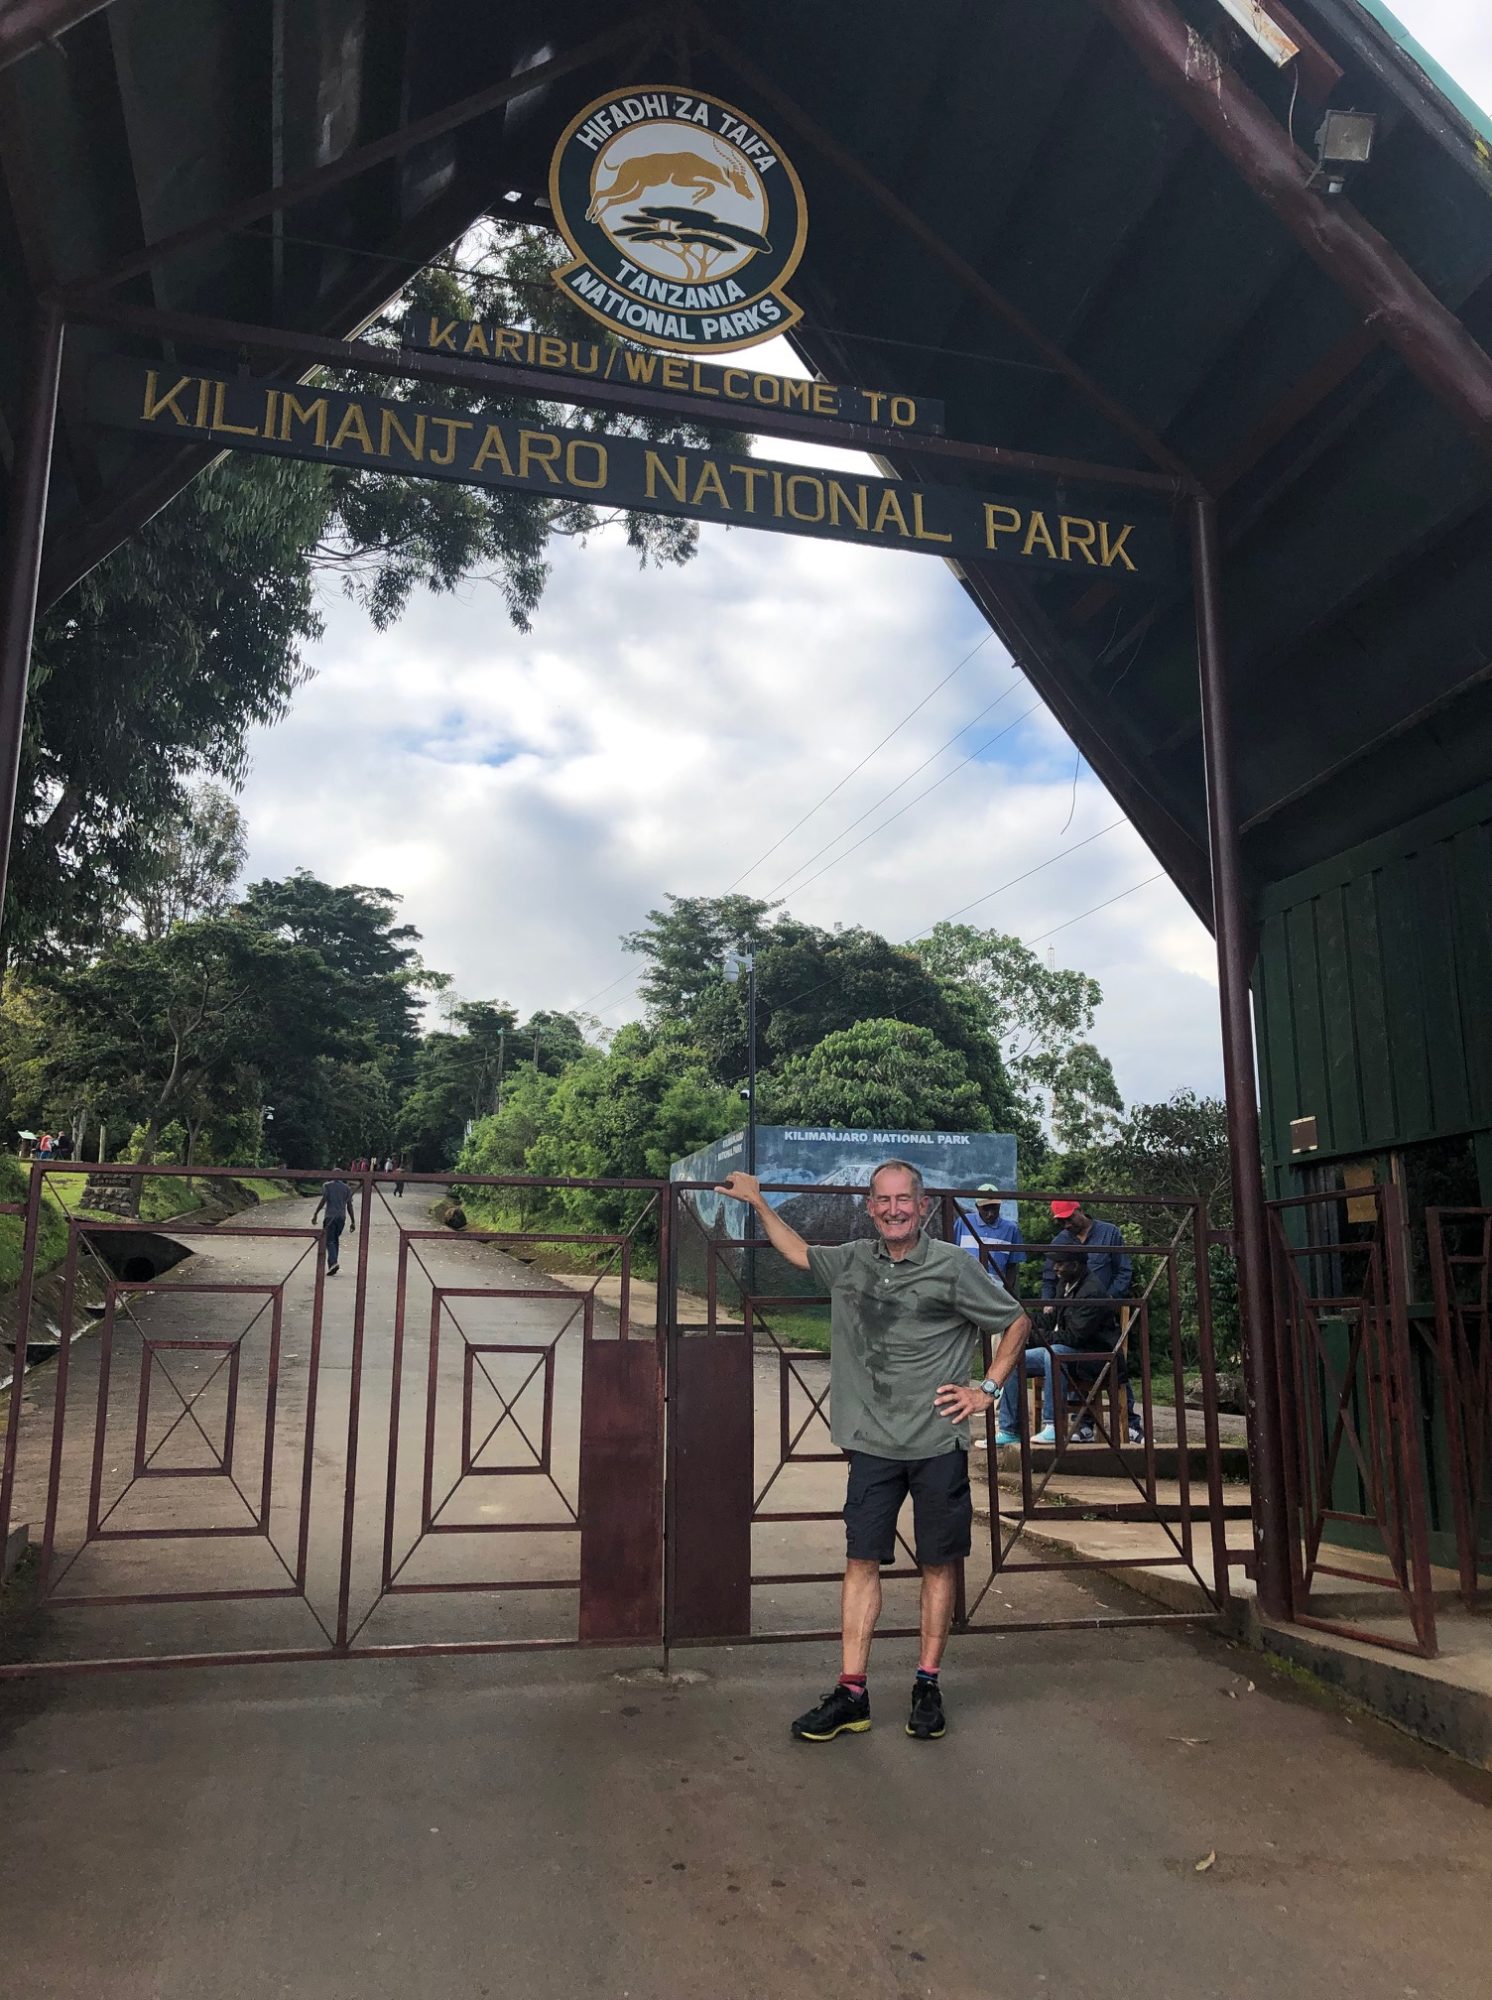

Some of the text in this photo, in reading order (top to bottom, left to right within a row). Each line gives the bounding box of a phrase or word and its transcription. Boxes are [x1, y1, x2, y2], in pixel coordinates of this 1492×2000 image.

[577, 95, 777, 173] HIFADHI ZA TAIFA
[571, 271, 781, 340] NATIONAL PARKS
[616, 259, 746, 308] TANZANIA
[862, 390, 916, 427] TO
[140, 369, 1138, 572] KILIMANJARO NATIONAL PARK
[784, 1131, 970, 1145] KILIMANJARO NATIONAL PARK
